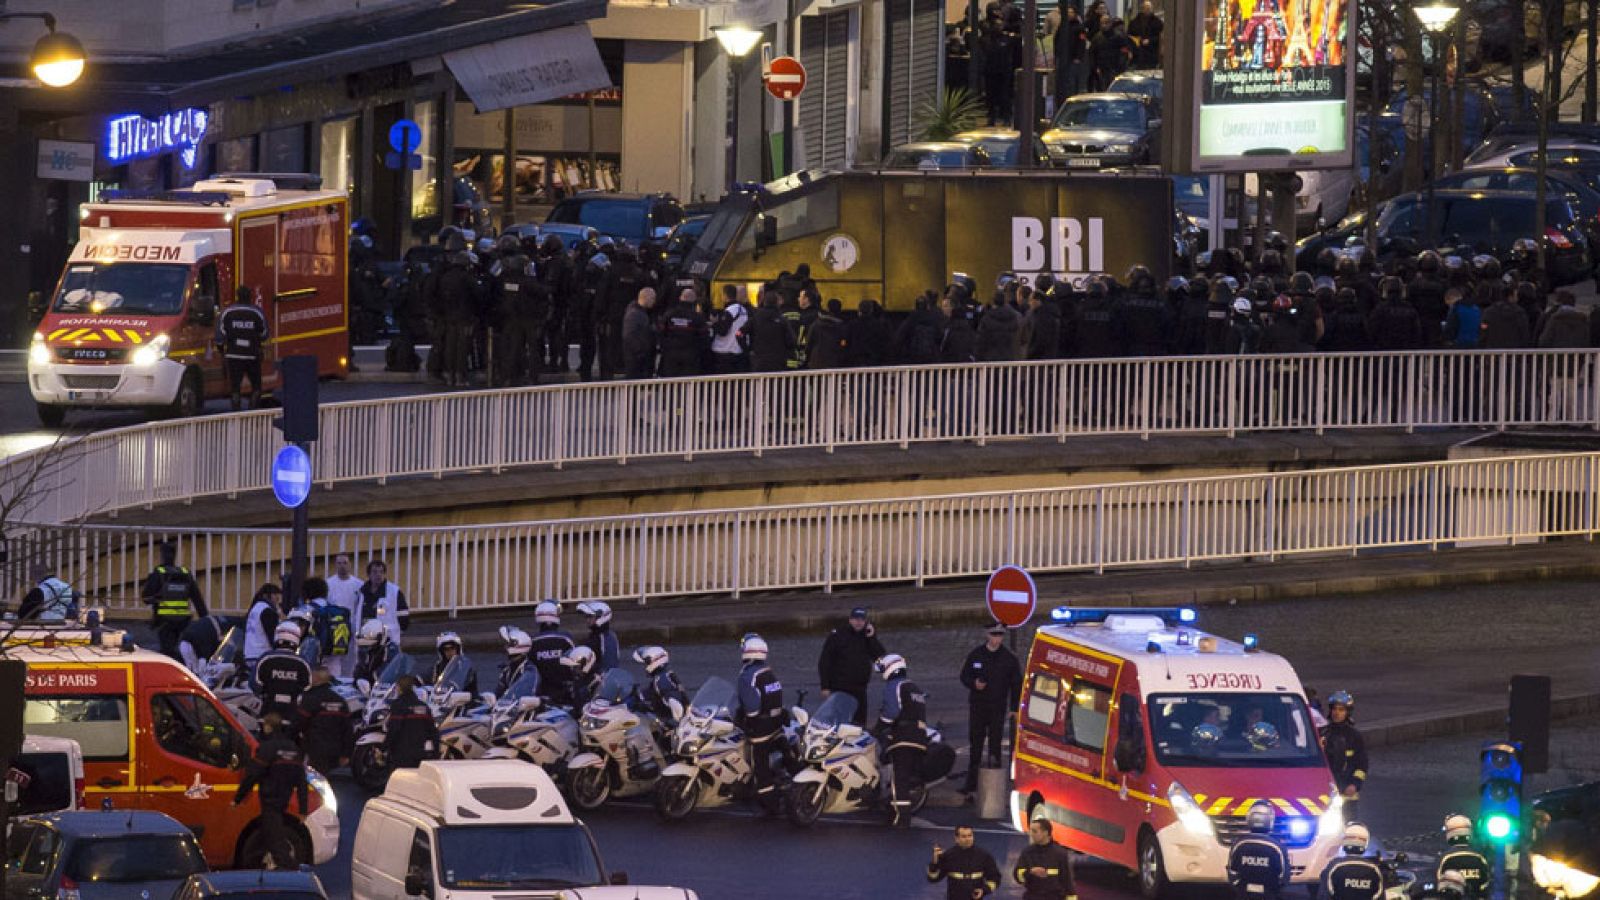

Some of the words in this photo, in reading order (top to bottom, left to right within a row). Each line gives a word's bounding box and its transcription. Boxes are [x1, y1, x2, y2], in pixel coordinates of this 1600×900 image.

[1012, 216, 1104, 272] BRI
[232, 320, 256, 329] POLICE
[74, 350, 106, 359] IVECO
[38, 674, 56, 687] DE
[59, 673, 97, 687] PARIS
[272, 669, 298, 681] POLICE
[1241, 855, 1269, 867] POLICE
[1344, 877, 1372, 889] POLICE
